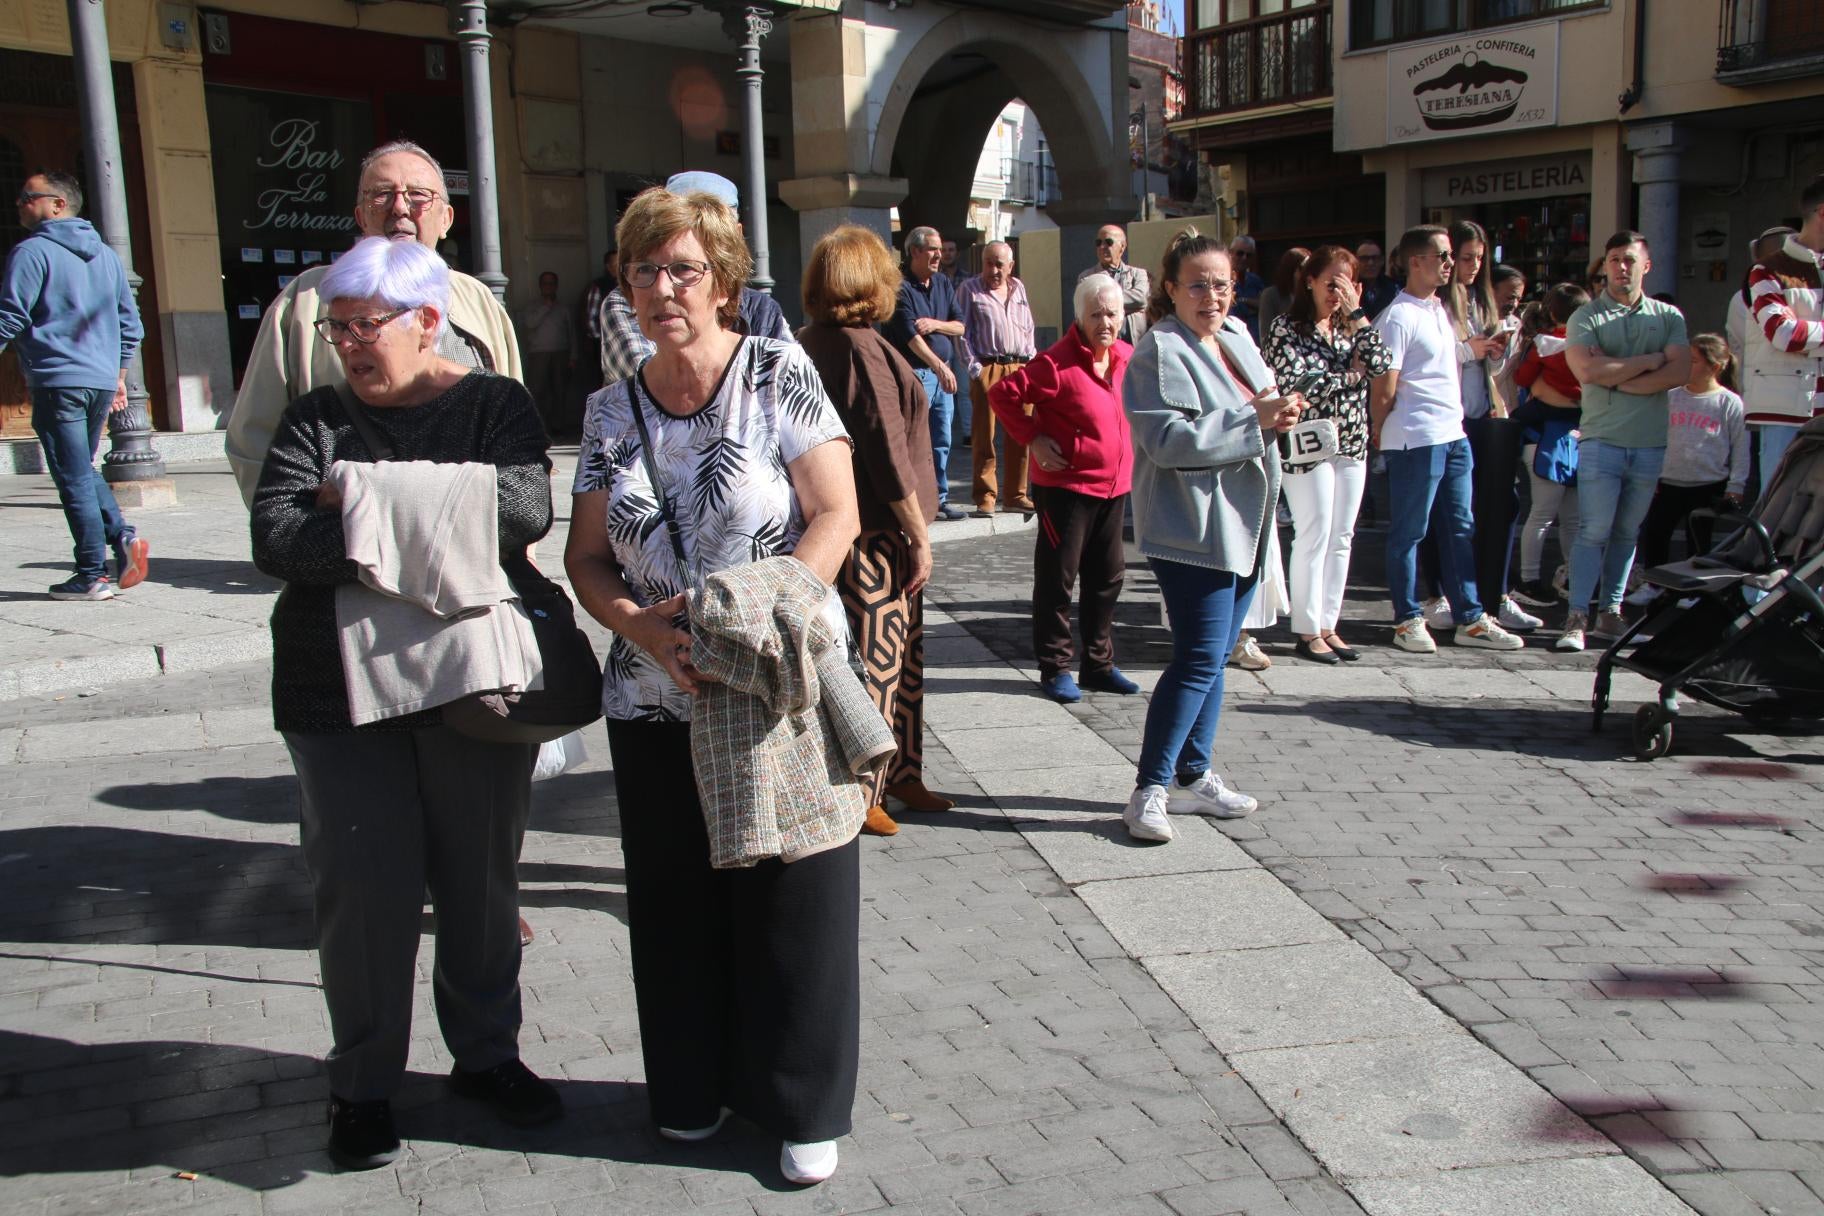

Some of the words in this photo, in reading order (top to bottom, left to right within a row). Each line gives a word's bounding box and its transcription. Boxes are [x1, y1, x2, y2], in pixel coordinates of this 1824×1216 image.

[1406, 45, 1461, 78] PASTELERIA
[1476, 40, 1536, 59] CONFITERIA
[1425, 89, 1512, 112] TERESIANA
[257, 119, 344, 169] Bar
[290, 173, 327, 202] La
[1448, 161, 1585, 197] PASTELERÍA
[243, 189, 356, 230] Terraza
